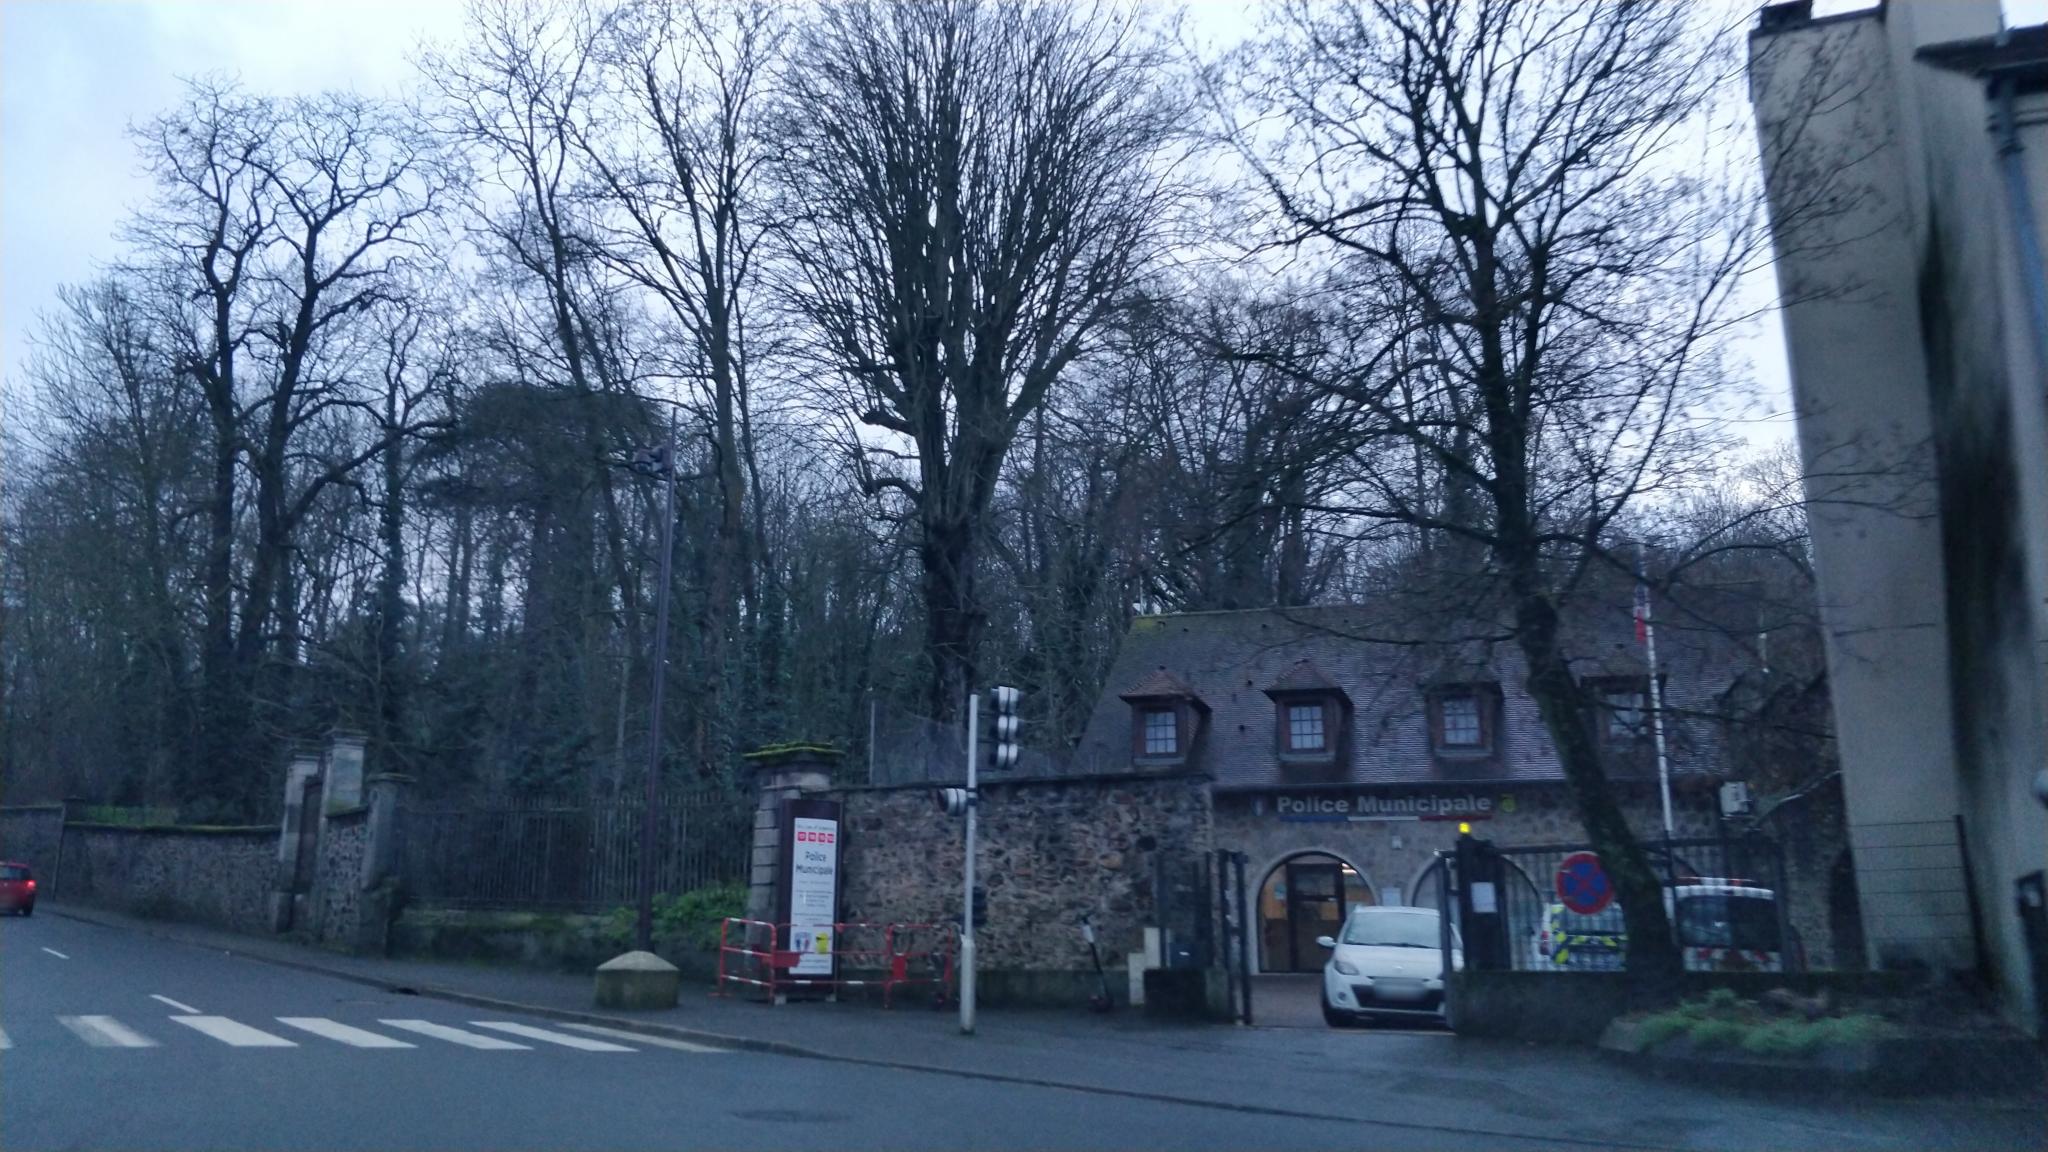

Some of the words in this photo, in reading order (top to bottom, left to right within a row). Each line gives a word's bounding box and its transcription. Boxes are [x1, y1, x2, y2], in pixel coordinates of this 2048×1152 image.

[1277, 797, 1349, 813] Police
[1357, 794, 1491, 815] Municipale
[805, 851, 827, 862] Police
[795, 863, 833, 876] Municipale
